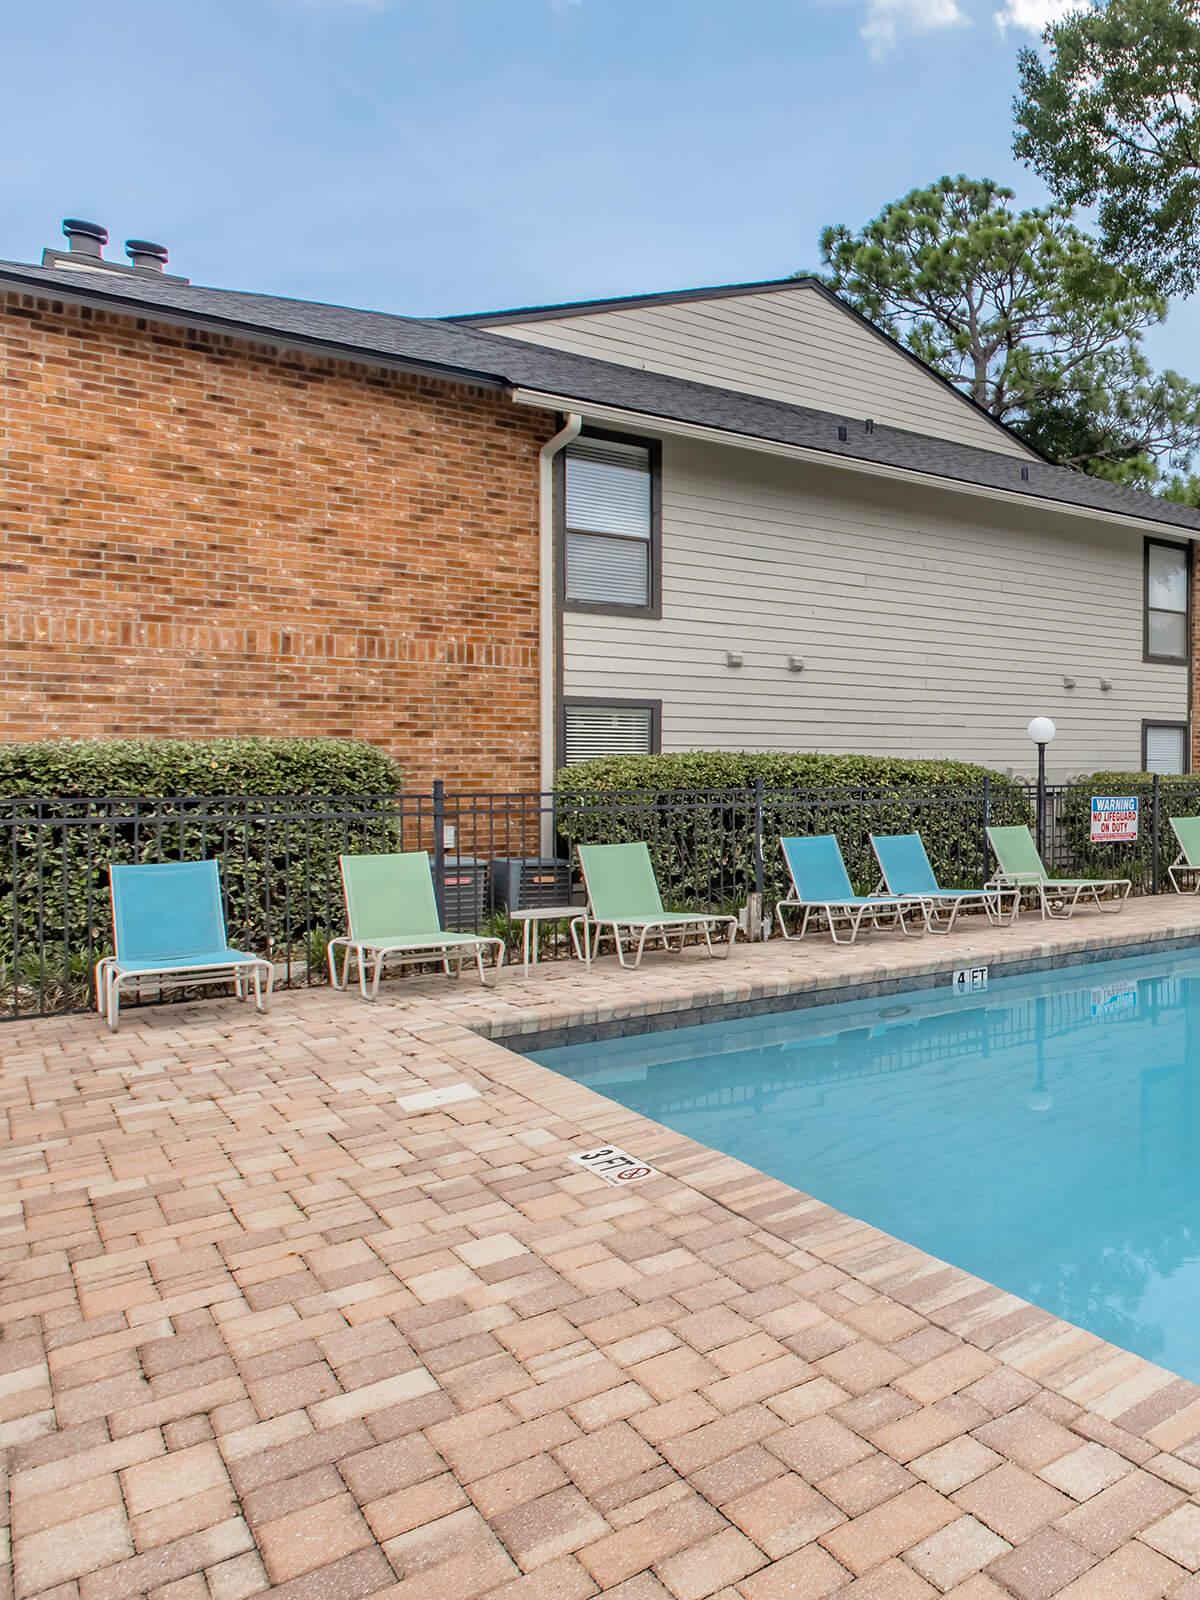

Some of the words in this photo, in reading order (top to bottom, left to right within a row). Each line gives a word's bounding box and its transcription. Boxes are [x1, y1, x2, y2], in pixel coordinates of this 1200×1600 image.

[1096, 799, 1135, 810] WARNING
[1093, 812, 1102, 821] NO
[1103, 811, 1137, 821] LIFEGUARD
[1101, 823, 1110, 832] ON
[1111, 822, 1128, 832] DUTY
[957, 971, 966, 984] 4
[971, 968, 986, 983] FT
[580, 1149, 614, 1160] 3
[591, 1156, 636, 1172] FT
